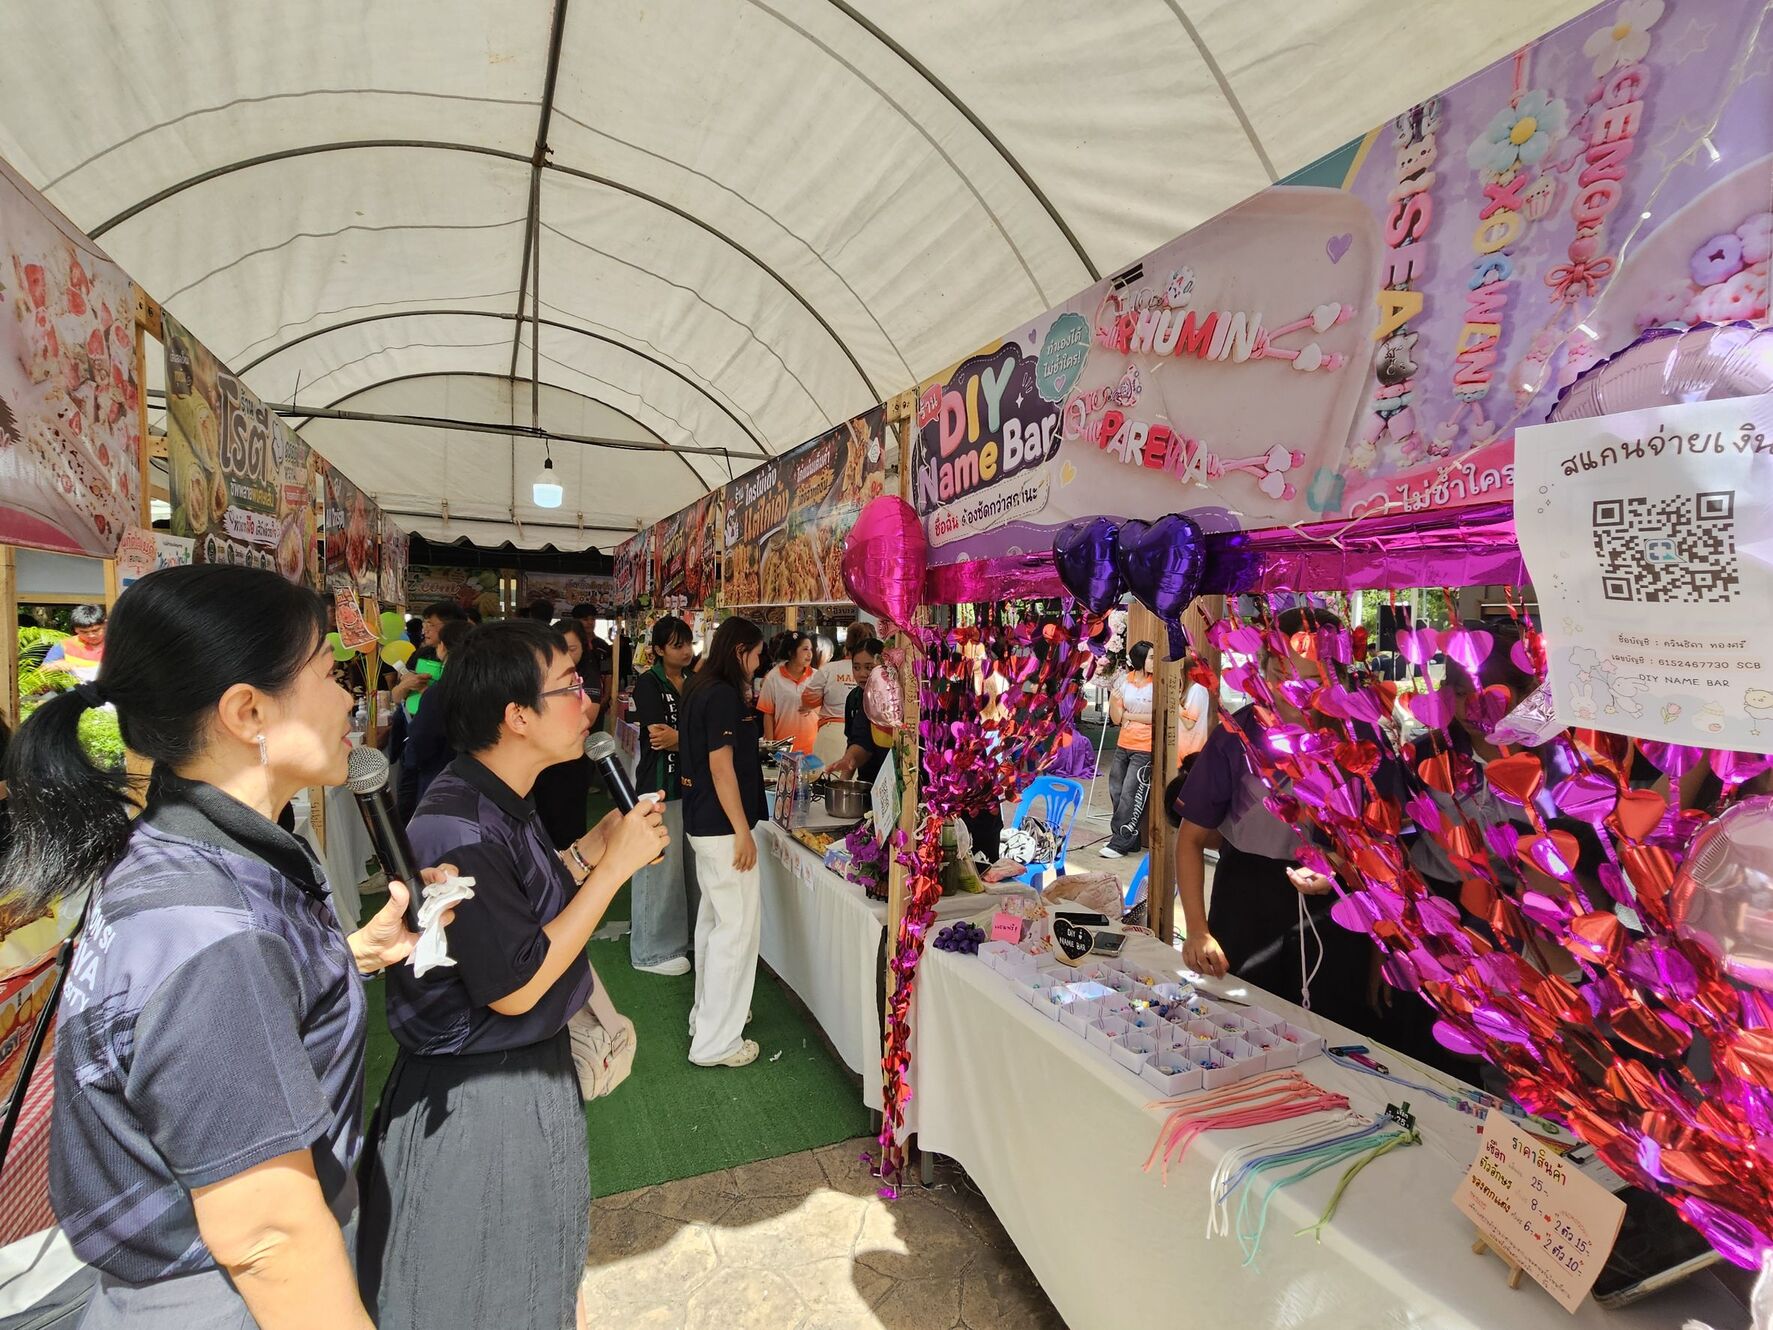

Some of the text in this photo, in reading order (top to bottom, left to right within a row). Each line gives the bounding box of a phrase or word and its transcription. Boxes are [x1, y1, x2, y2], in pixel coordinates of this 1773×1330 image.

[1047, 327, 1082, 356] ทำเองได้
[1117, 309, 1262, 363] PHUMIN
[1044, 351, 1082, 378] ไม่ซ้ำใคร!
[919, 395, 938, 418] ร้าน
[939, 356, 1016, 458] DIY
[217, 372, 269, 487] โรตี
[918, 413, 1057, 511] Name Bar
[935, 512, 958, 537] ชื่อฉัน
[1638, 674, 1730, 688] DIY NAME BAR
[1658, 659, 1729, 669] 6152467730
[1736, 662, 1761, 670] SCB
[1479, 1156, 1512, 1190] ตัวอักษร
[1512, 1137, 1566, 1186] ราคาสินค้า
[1471, 1175, 1511, 1213] ของตกแต่ง
